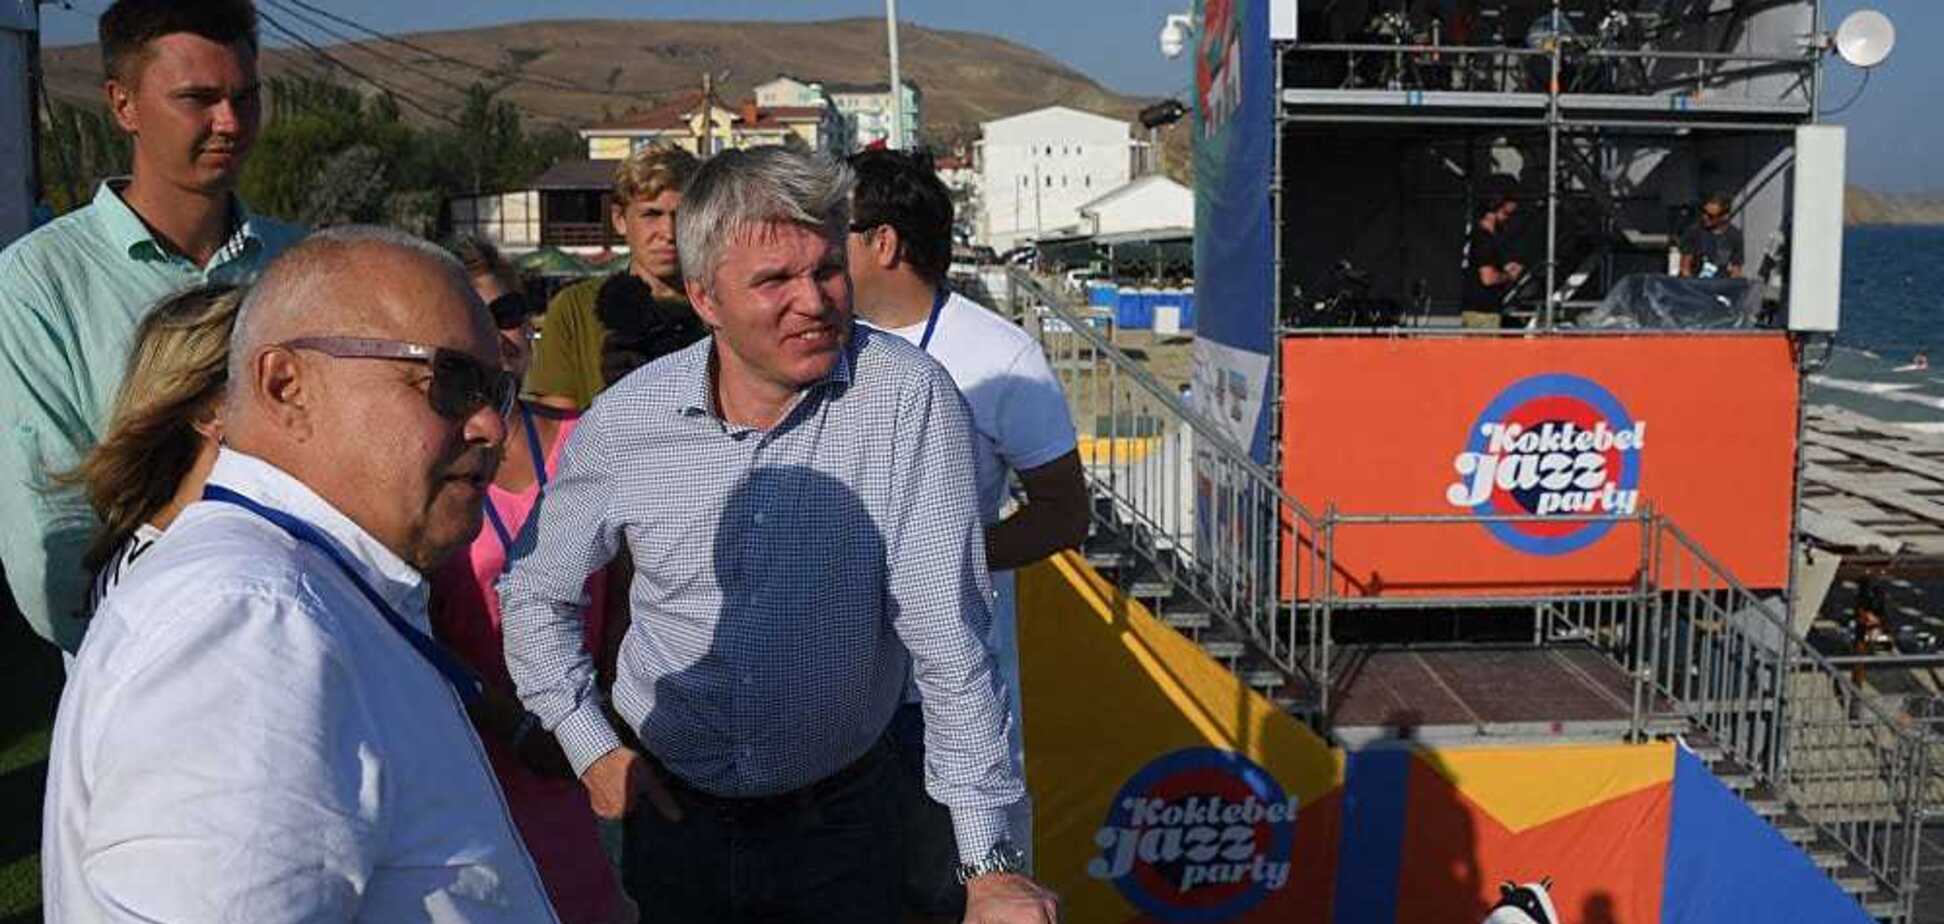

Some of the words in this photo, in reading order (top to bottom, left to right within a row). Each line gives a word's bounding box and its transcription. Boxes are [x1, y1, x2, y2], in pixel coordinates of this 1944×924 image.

[1481, 420, 1646, 453] Koktebel
[1536, 481, 1639, 515] party
[1122, 795, 1298, 826] Koktebel
[1179, 854, 1291, 893] party
